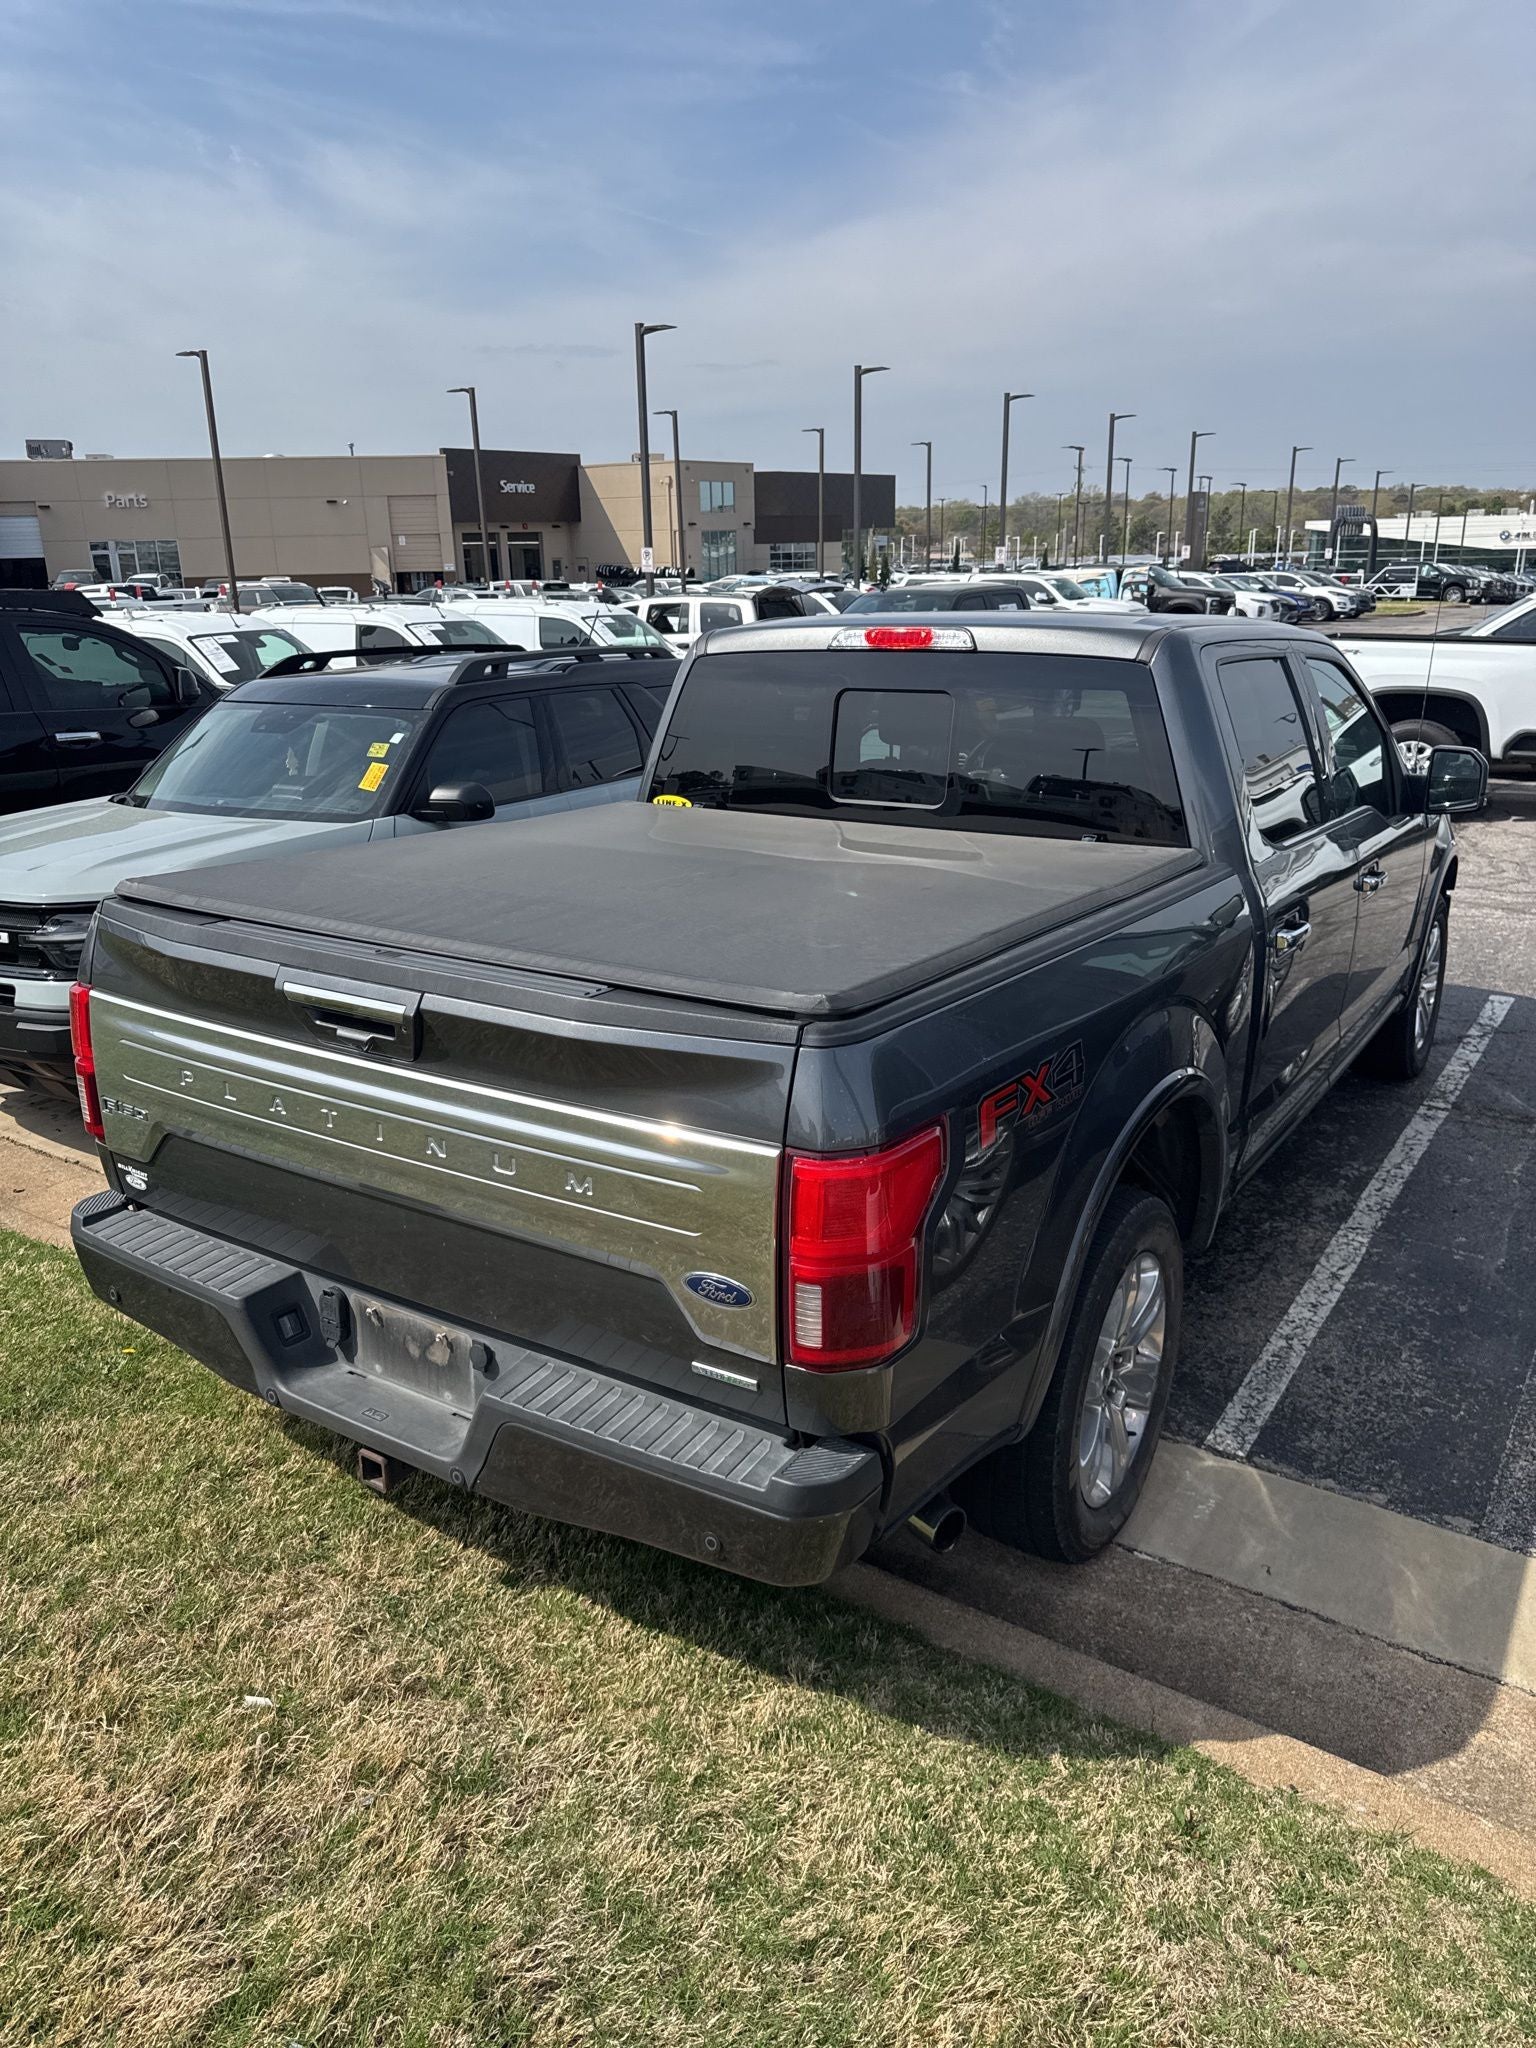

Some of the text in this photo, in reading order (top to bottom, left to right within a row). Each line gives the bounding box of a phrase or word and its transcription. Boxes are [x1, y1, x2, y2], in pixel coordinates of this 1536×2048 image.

[104, 491, 148, 508] Parts
[500, 480, 536, 494] Service
[977, 1039, 1085, 1151] FX4
[179, 1070, 594, 1196] PLATINUM
[697, 1279, 738, 1304] Ford
